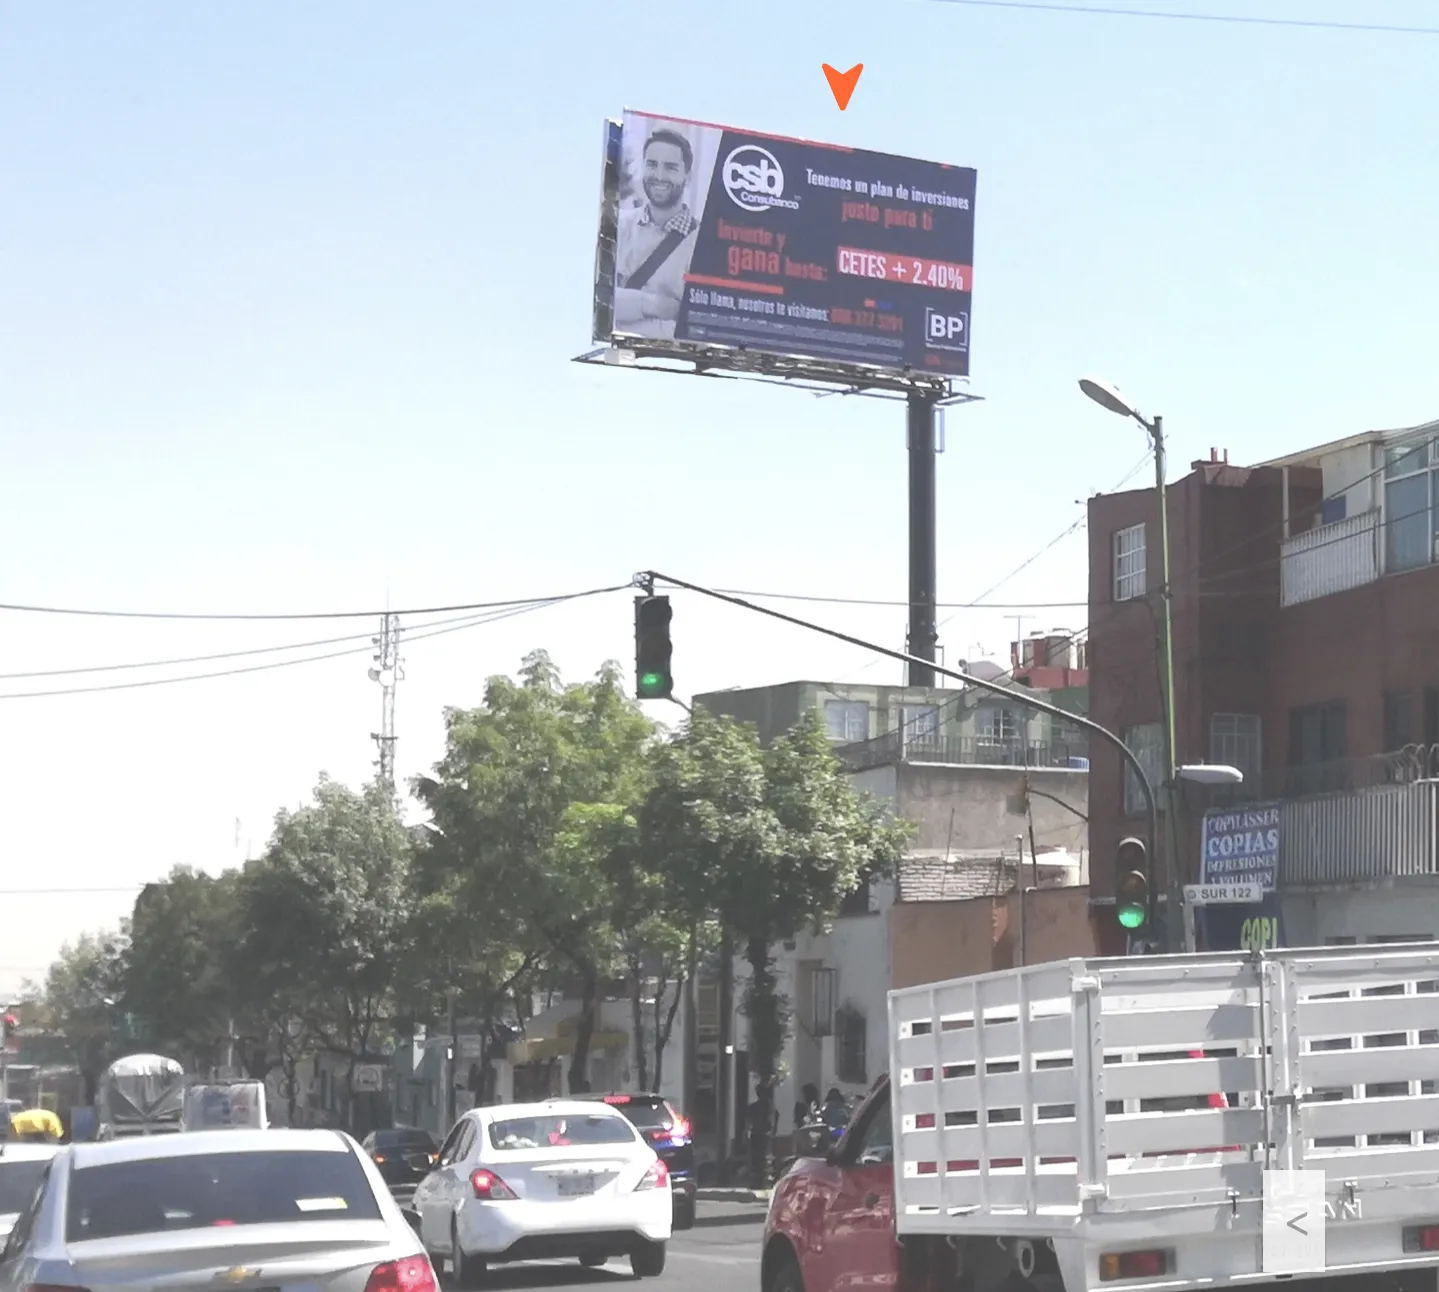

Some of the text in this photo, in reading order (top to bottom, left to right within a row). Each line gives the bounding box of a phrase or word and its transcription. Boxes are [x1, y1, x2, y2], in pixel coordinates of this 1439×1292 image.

[725, 159, 782, 197] csb
[805, 168, 970, 210] Tenemos un plan de inversiones
[728, 245, 780, 276] gana
[839, 250, 964, 291] CETES + 2.40%
[710, 290, 737, 310] llama,
[738, 297, 775, 314] nosotros
[777, 302, 786, 316] te
[929, 313, 965, 339] BP
[1208, 829, 1278, 857] COPIAS
[1201, 888, 1252, 899] SUR 122
